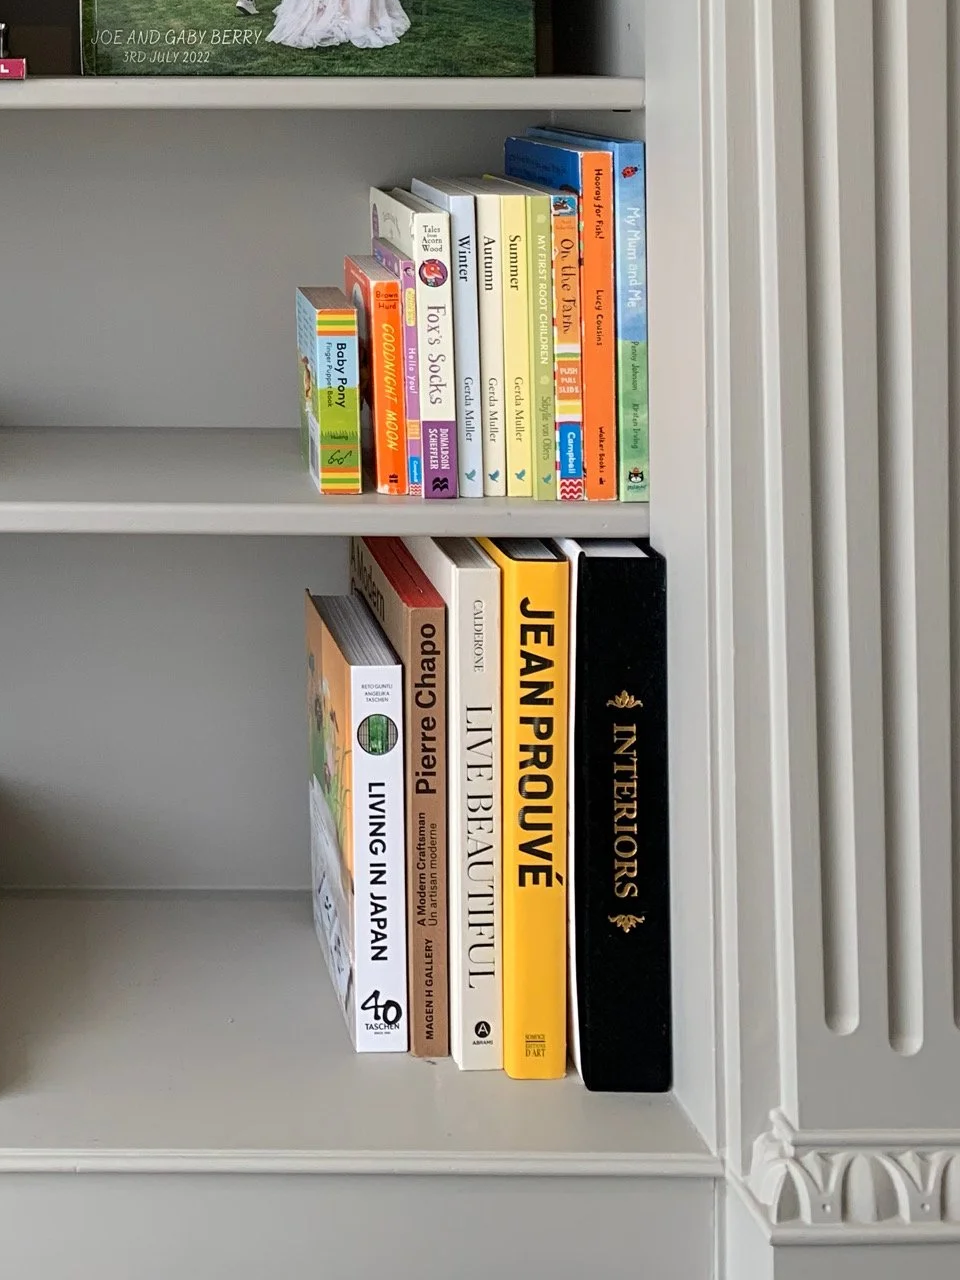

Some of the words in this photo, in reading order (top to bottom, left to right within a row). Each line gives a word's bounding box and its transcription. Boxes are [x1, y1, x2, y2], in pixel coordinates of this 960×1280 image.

[90, 29, 123, 45] JOE
[126, 29, 160, 44] AND
[165, 29, 207, 44] GABY
[210, 29, 263, 44] BERRY
[122, 51, 146, 63] 3RD
[149, 51, 179, 63] JULY
[182, 51, 211, 63] 2022
[625, 208, 641, 225] My
[458, 235, 471, 281] Winter
[538, 235, 546, 251] MY
[561, 239, 575, 260] On
[627, 230, 641, 260] Mum
[483, 235, 496, 291] Autumn
[509, 235, 522, 290] Summer
[539, 253, 547, 280] FIRST
[561, 265, 575, 291] the
[628, 264, 640, 286] and
[540, 283, 548, 312] ROOT
[562, 297, 576, 335] Farm
[627, 289, 640, 308] Me
[427, 304, 446, 346] Fox's
[540, 315, 549, 364] CHILDREN
[334, 342, 347, 374] Baby
[381, 323, 398, 403] GOODNIGHT
[335, 377, 347, 408] Pony
[428, 353, 447, 404] Socks
[464, 377, 474, 406] Gerda
[488, 377, 498, 407] Gerda
[514, 376, 524, 406] Gerda
[385, 409, 399, 451] MOON
[465, 409, 475, 441] Muller
[489, 410, 499, 442] Muller
[515, 409, 525, 441] Muller
[429, 428, 439, 470] SCHEFFLER
[439, 428, 450, 470] DONALDSON
[473, 600, 485, 672] CALDERONE
[519, 597, 556, 706] JEAN
[415, 623, 441, 708] Chapo
[415, 717, 437, 795] Pierre
[465, 704, 494, 780] LIVE
[368, 782, 385, 856] LIVING
[519, 717, 564, 888] PROUVÉ
[613, 723, 639, 898] INTERIORS
[369, 862, 386, 885] IN
[465, 791, 496, 989] BEAUTIFUL
[370, 892, 387, 961] JAPAN
[361, 989, 402, 1025] 40
